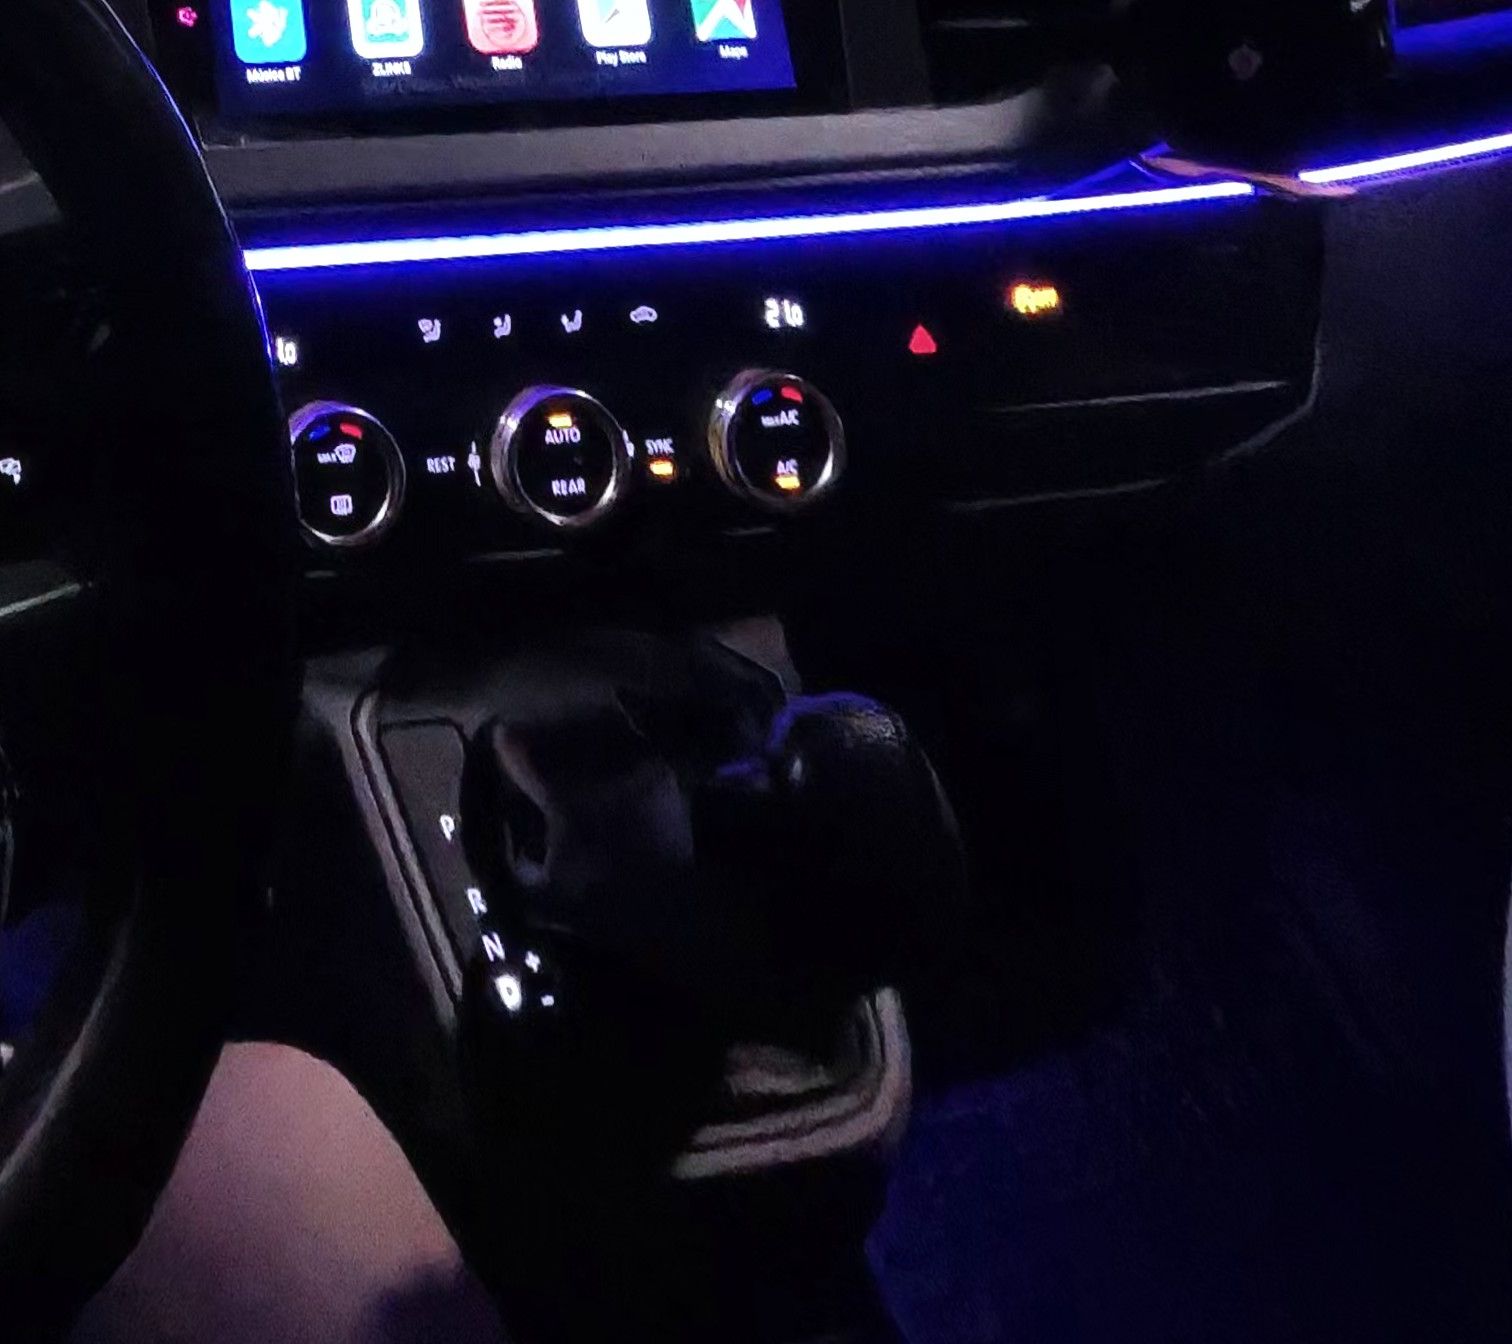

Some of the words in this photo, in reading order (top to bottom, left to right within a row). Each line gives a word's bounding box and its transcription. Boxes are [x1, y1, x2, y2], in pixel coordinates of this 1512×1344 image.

[596, 51, 618, 67] Play
[619, 50, 646, 64] Store
[719, 44, 748, 60] Maps
[491, 56, 522, 71] Radio
[285, 66, 301, 81] BT
[545, 427, 581, 445] AUTO
[645, 438, 675, 455] SYNC
[427, 456, 456, 473] REST
[776, 459, 798, 475] A/C
[551, 477, 586, 496] REAR
[440, 814, 455, 841] P
[466, 887, 487, 915] R
[481, 932, 505, 962] N
[494, 973, 522, 1011] D
